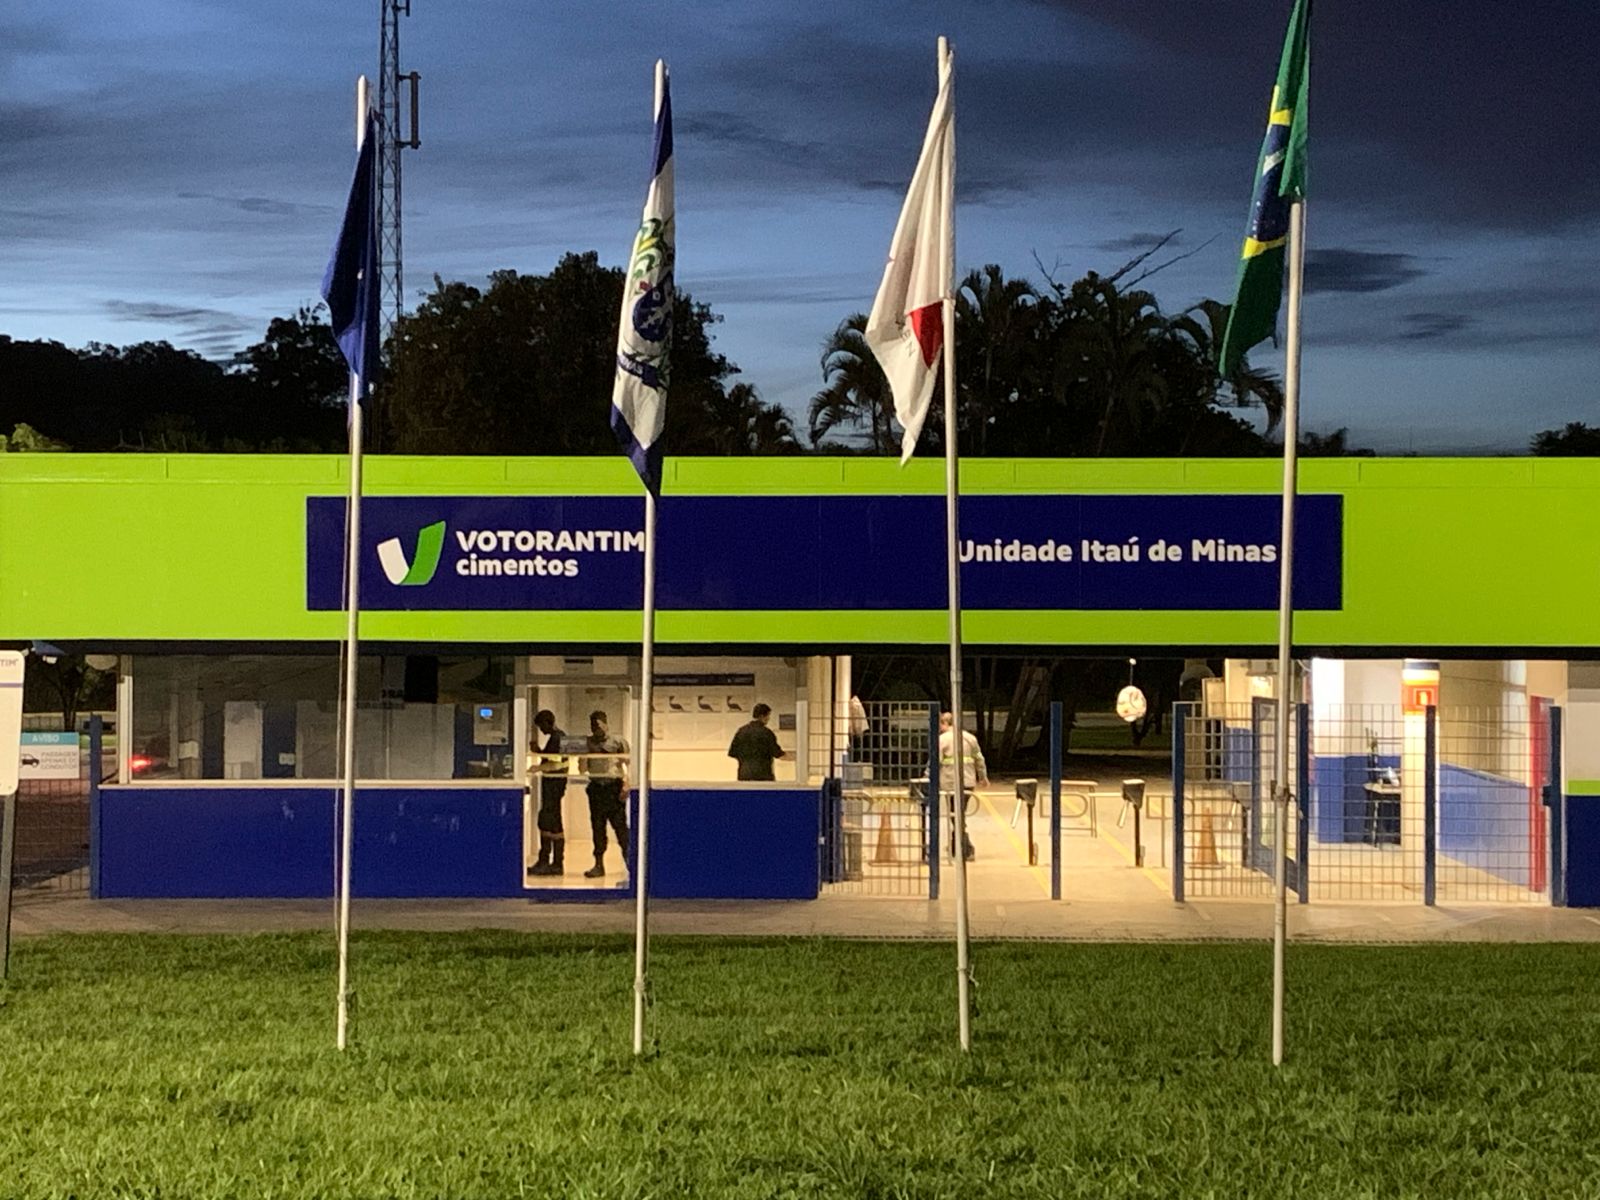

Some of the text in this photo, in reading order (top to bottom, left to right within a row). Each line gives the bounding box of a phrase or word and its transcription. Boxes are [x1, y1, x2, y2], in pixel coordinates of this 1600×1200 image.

[456, 530, 645, 552] VOTORANTIM
[959, 536, 1277, 562] Unidade Itaú de Minas
[456, 553, 579, 577] cimentos
